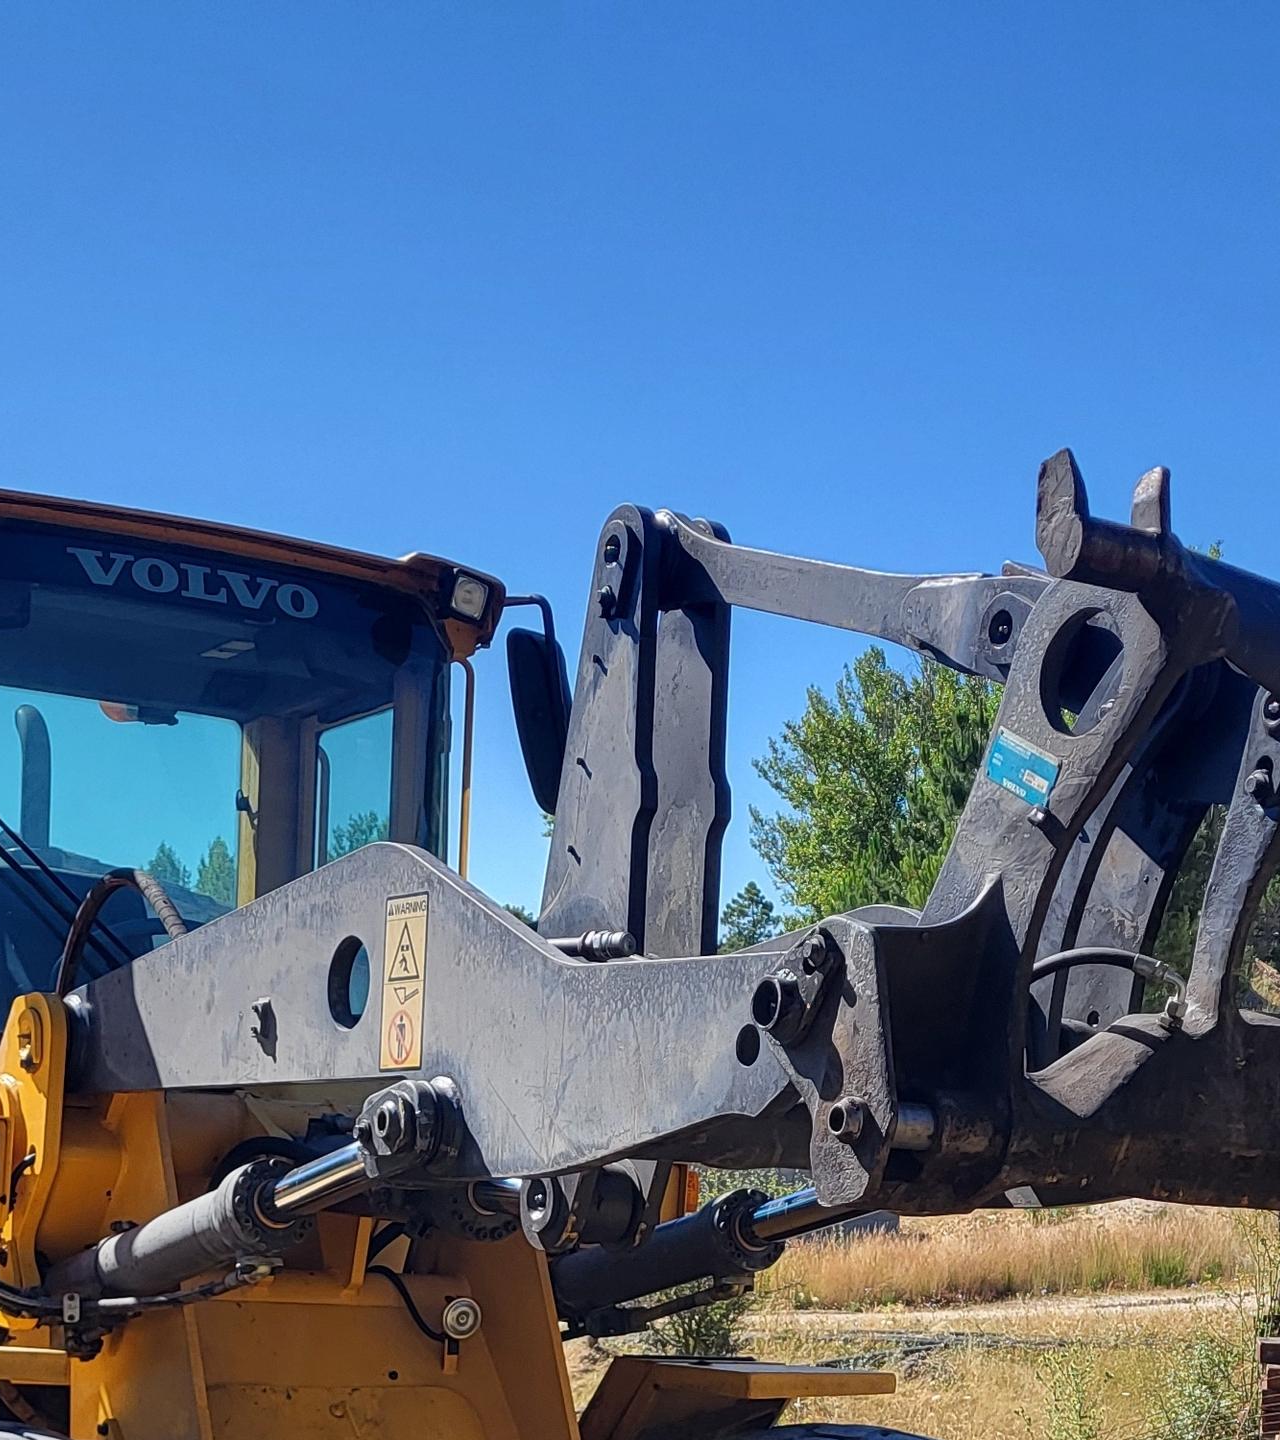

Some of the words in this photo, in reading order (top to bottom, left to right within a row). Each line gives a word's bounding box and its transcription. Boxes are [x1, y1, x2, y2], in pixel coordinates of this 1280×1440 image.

[66, 546, 319, 619] VOLVO
[1002, 777, 1027, 798] VOLVO
[394, 900, 427, 916] WARNING
